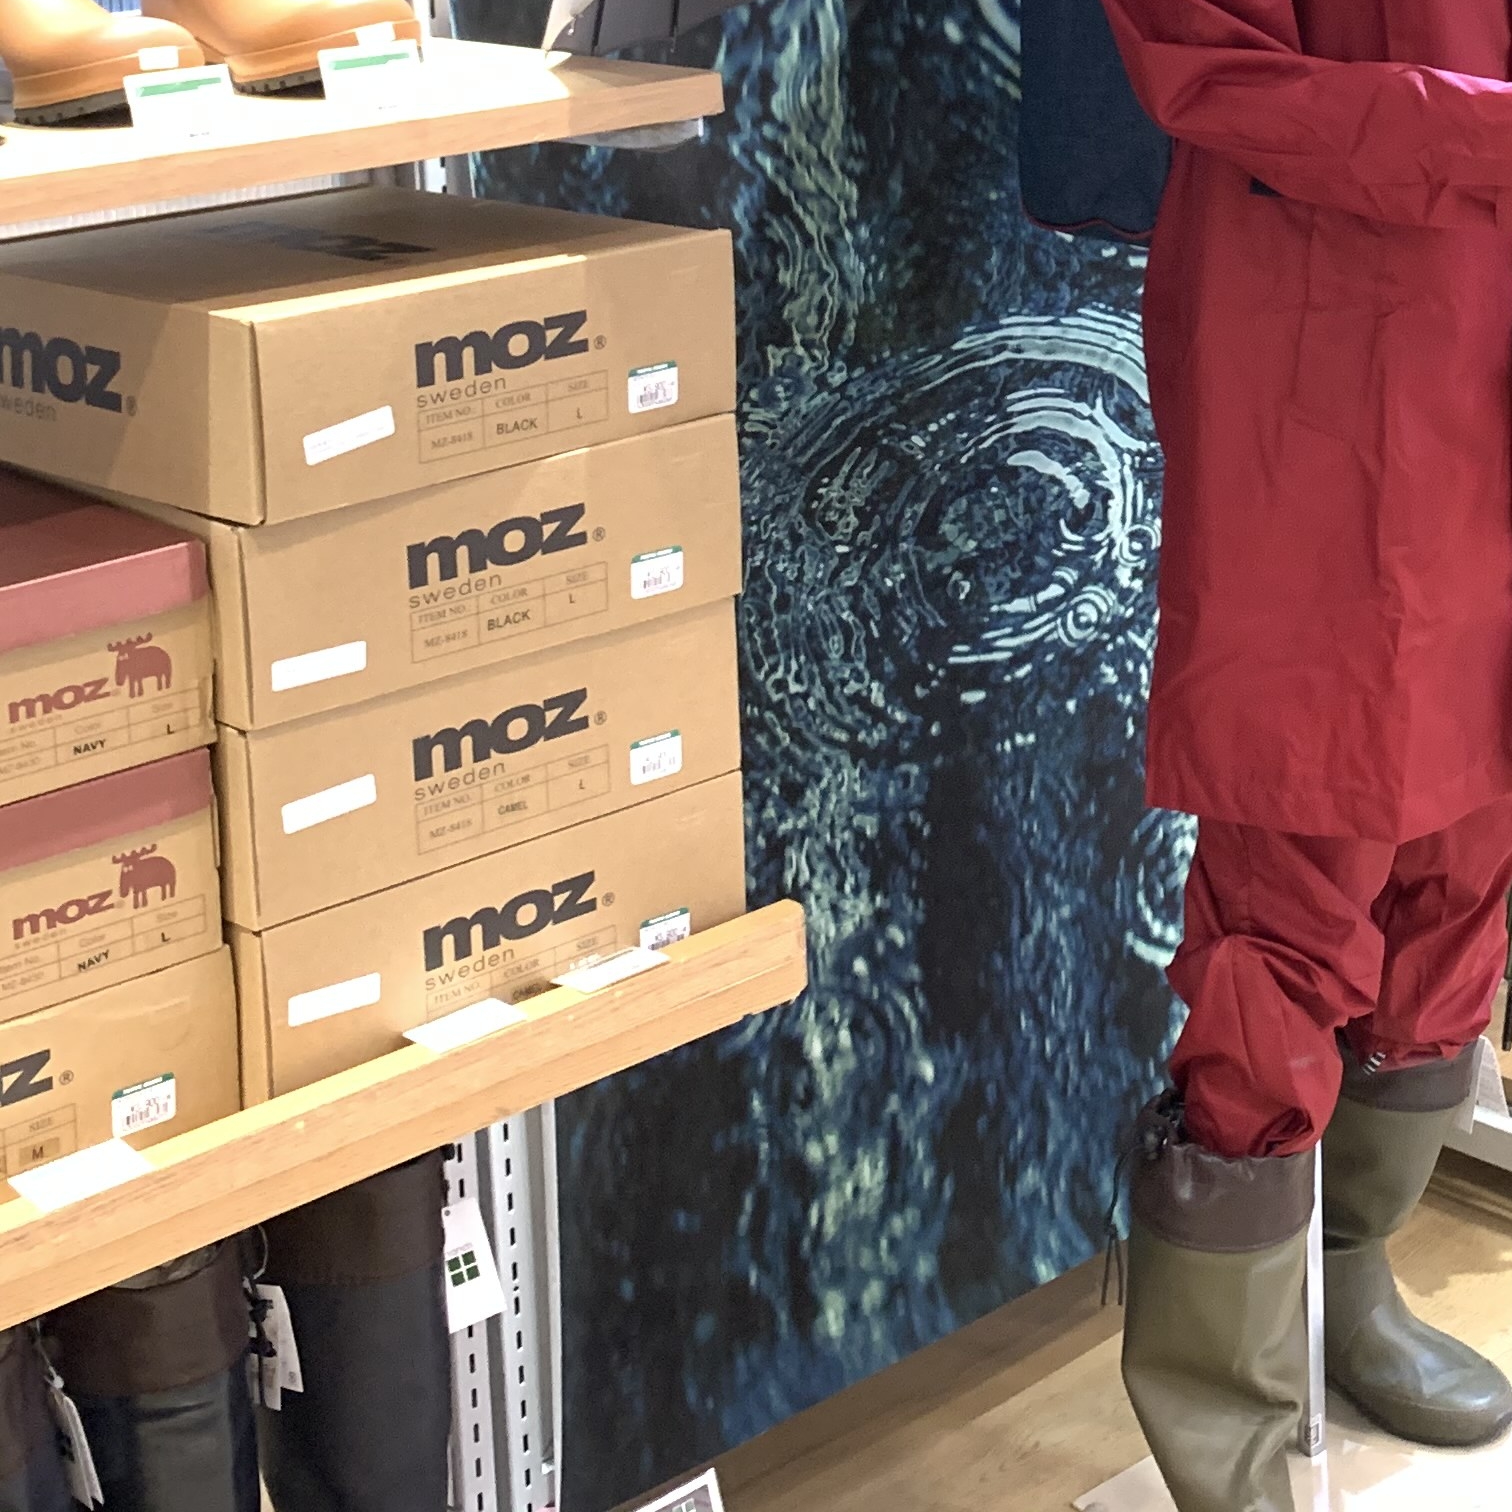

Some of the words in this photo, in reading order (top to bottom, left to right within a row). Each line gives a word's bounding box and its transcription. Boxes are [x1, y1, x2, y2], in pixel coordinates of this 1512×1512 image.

[415, 309, 589, 388] moz
[0, 325, 123, 413] moz
[417, 376, 507, 409] sweden
[568, 378, 589, 392] SIZE
[0, 394, 57, 422] weden
[494, 392, 531, 409] COLOR
[426, 409, 453, 425] ITEM
[576, 407, 583, 420] L
[496, 417, 538, 436] BLACK
[407, 502, 588, 590] moz
[565, 571, 589, 585] SIZE
[409, 572, 503, 610] sweden
[490, 587, 528, 606] COLOR
[569, 593, 576, 604] L
[418, 610, 447, 624] ITEM
[487, 608, 531, 631] BLACK
[8, 677, 111, 724] moz
[166, 723, 175, 735] L
[412, 687, 589, 782] moz
[73, 738, 107, 756] NAVY
[567, 754, 591, 770] SIZE
[414, 761, 506, 801] sweden
[494, 774, 531, 793] COLOR
[578, 778, 585, 790] L
[423, 800, 450, 816] ITEM
[497, 799, 529, 816] CAMEL
[12, 888, 115, 940] moz
[422, 869, 597, 972] moz
[161, 931, 171, 943] L
[576, 936, 600, 952] SIZE
[77, 948, 110, 972] NAVY
[425, 947, 516, 991] sweden
[503, 957, 541, 979] COLOR
[434, 988, 462, 1005] ITEM
[31, 1145, 44, 1161] M
